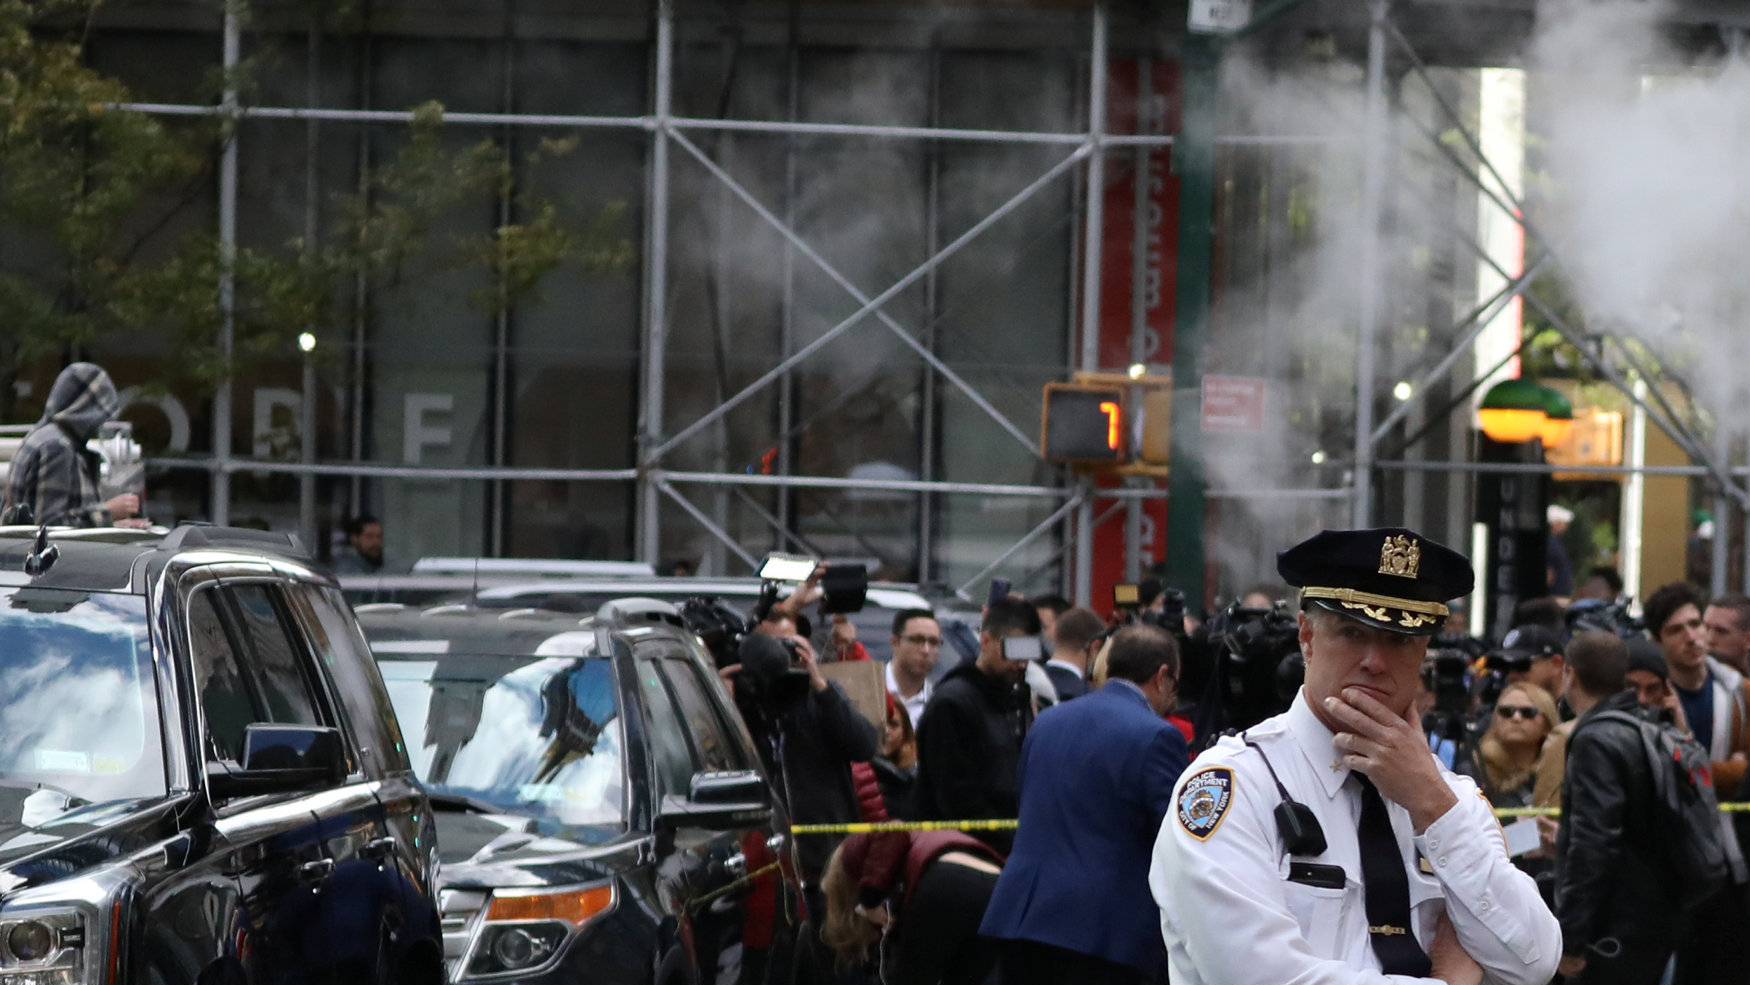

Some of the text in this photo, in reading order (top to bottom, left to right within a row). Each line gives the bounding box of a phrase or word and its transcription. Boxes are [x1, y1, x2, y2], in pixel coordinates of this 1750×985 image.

[1187, 771, 1216, 789] POLICE
[1205, 812, 1220, 830] NEW
[1217, 790, 1230, 813] YORK
